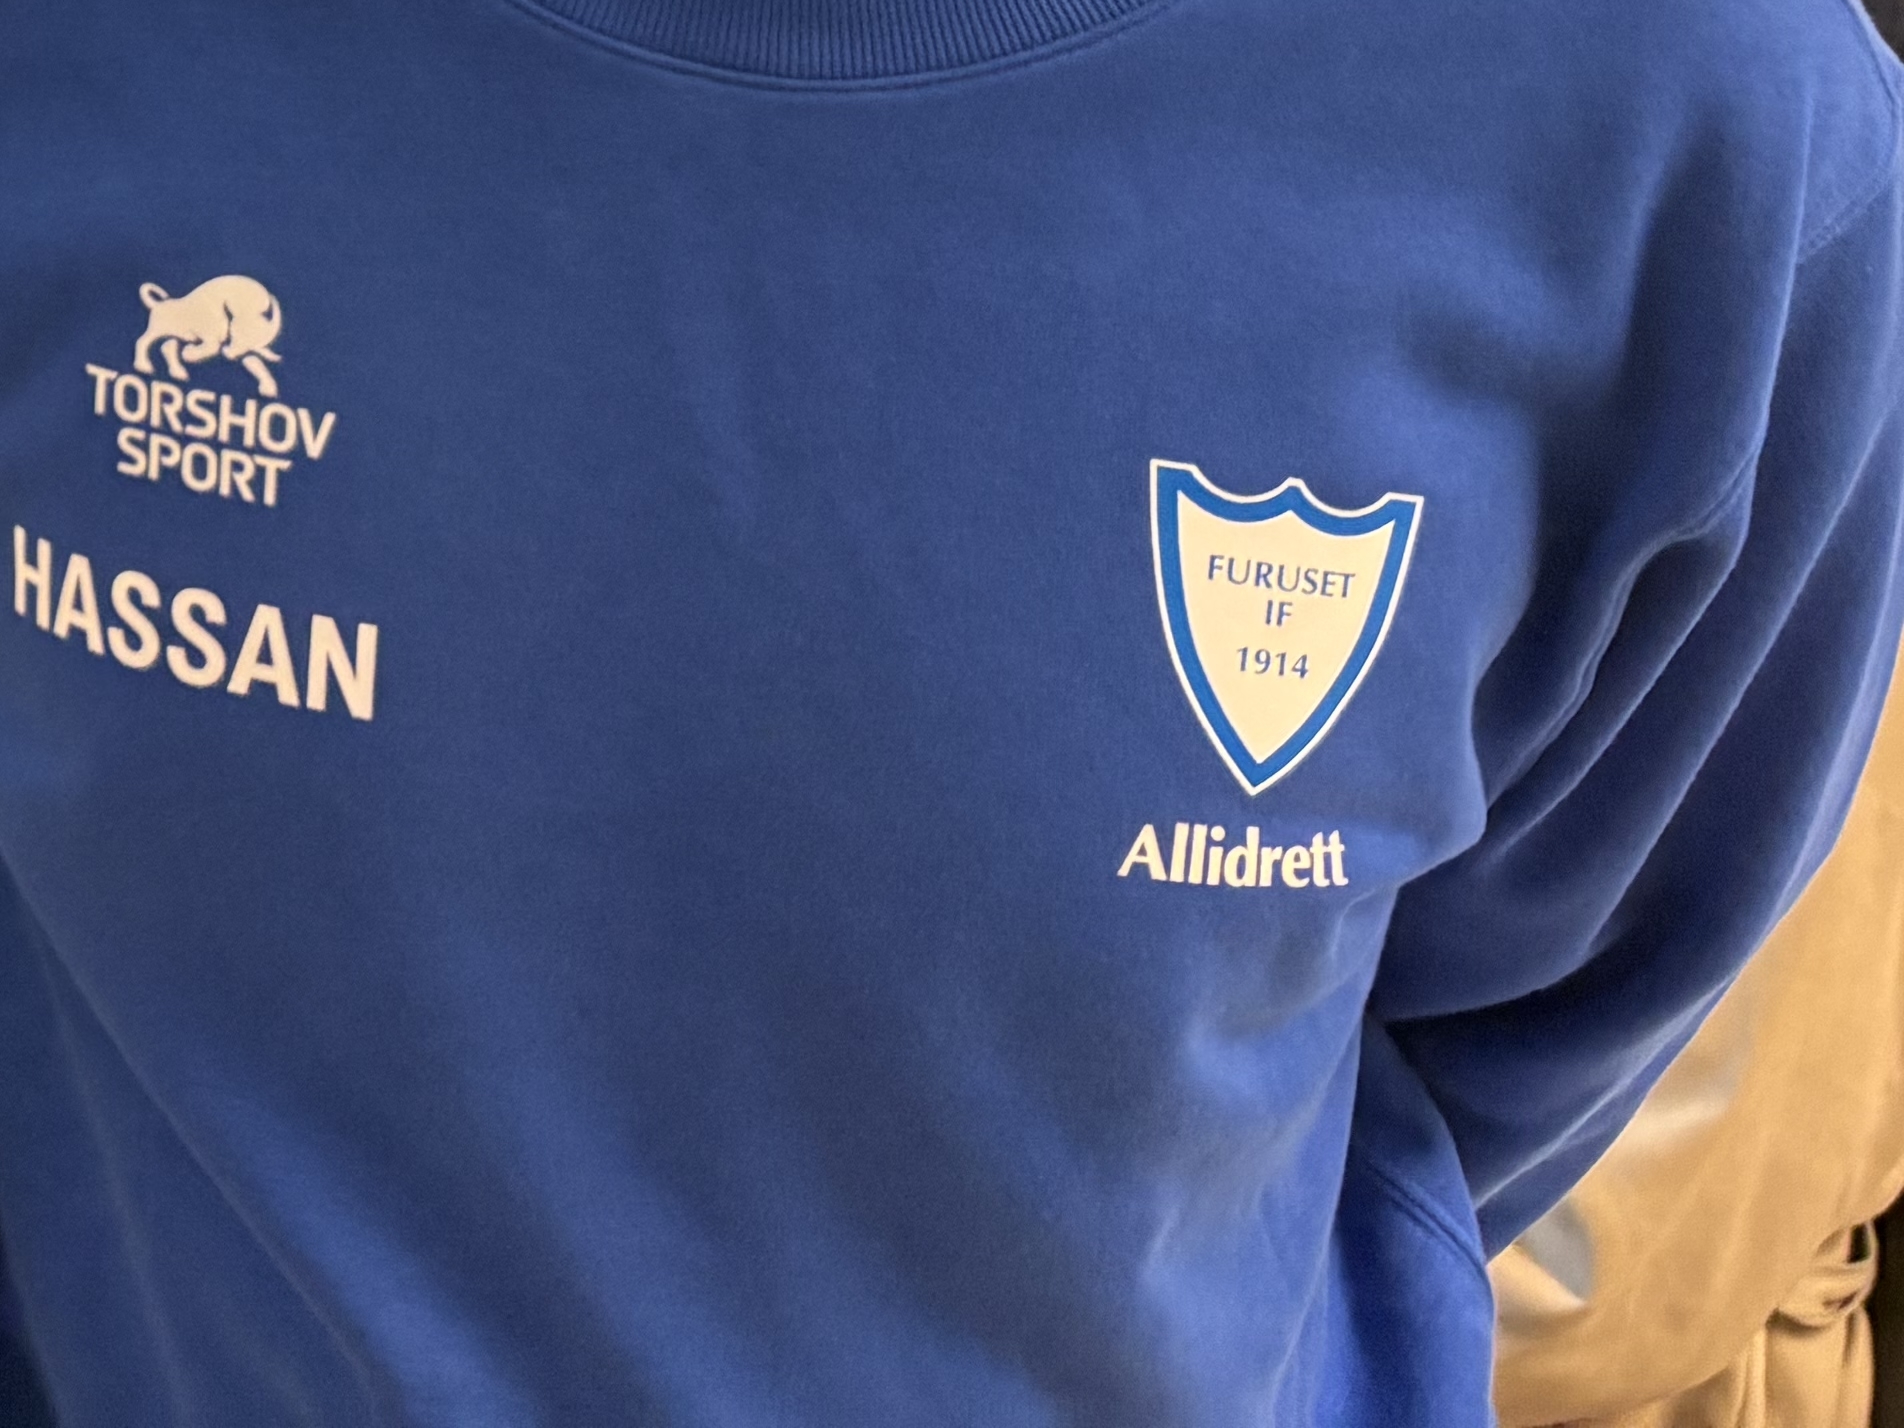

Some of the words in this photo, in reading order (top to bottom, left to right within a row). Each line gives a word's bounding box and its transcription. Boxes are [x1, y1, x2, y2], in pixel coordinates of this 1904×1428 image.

[85, 362, 337, 460] TORSHOV
[116, 427, 292, 507] SPORT
[1206, 554, 1356, 599] FURUSET
[13, 523, 379, 722] HASSAN
[1263, 599, 1294, 628] IF
[1236, 646, 1310, 679] 1914
[1116, 822, 1350, 888] Allidrett
